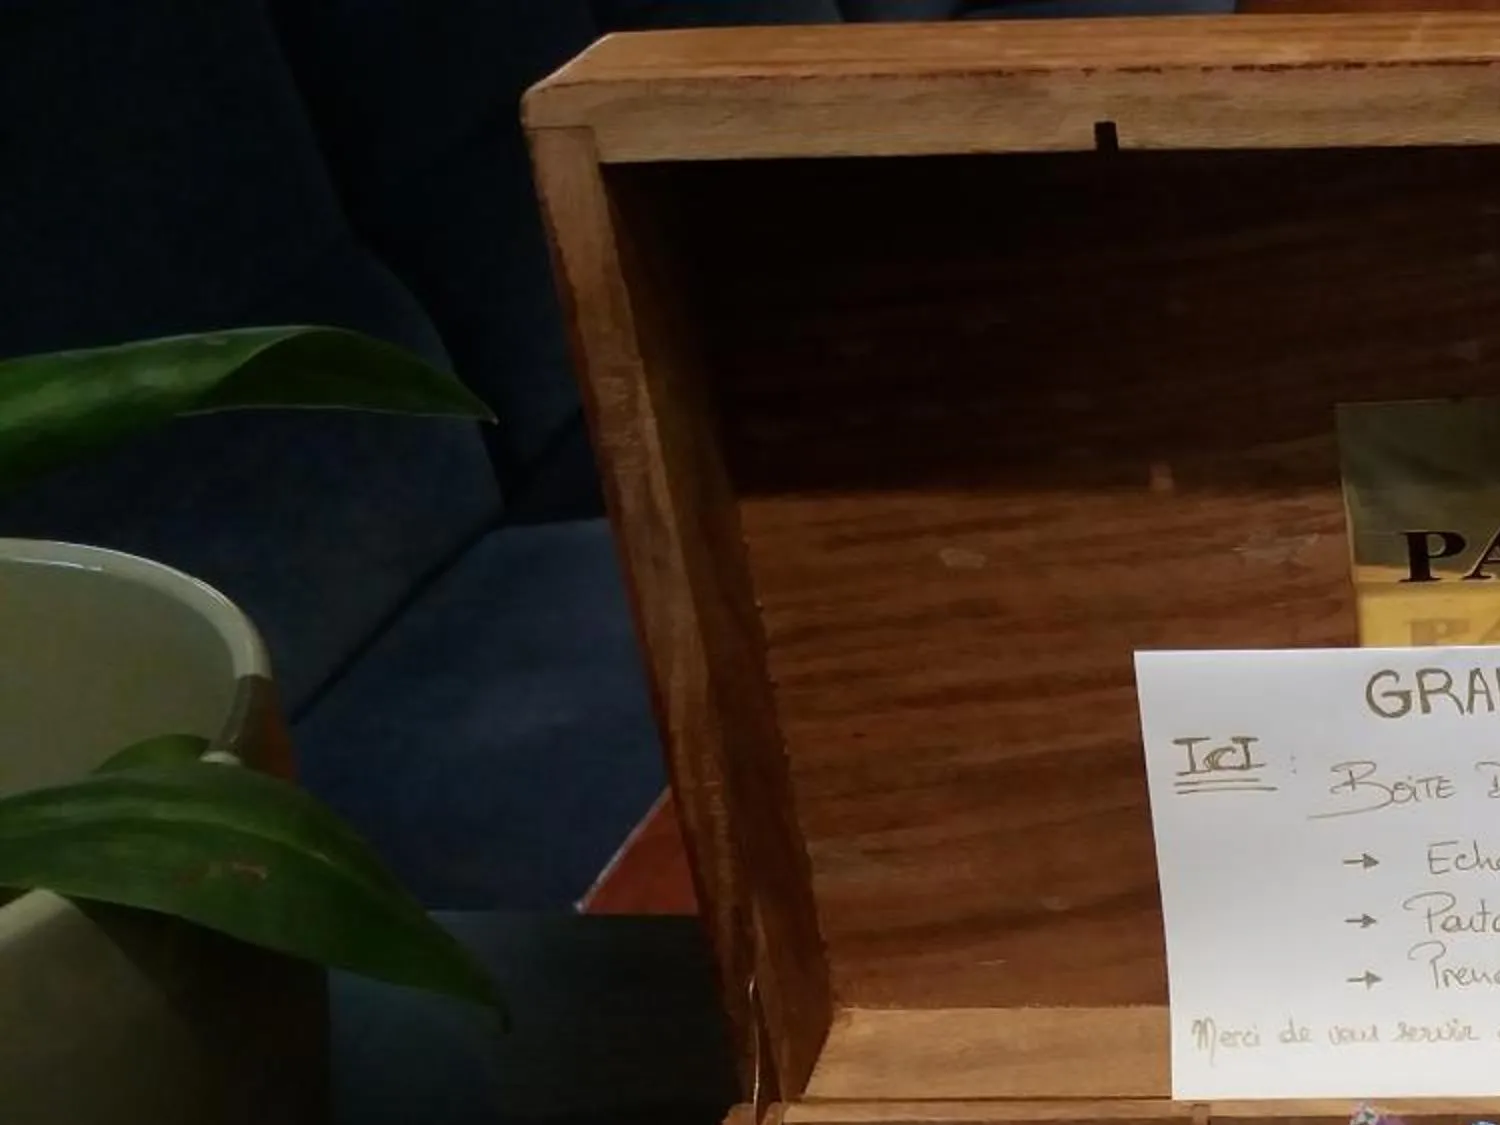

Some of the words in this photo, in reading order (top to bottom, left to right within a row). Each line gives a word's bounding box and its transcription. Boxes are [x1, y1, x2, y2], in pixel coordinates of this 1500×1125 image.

[1190, 1015, 1262, 1067] Merci
[1278, 1016, 1314, 1046] de
[1327, 1023, 1381, 1046] vous
[1391, 1016, 1480, 1044] servir
